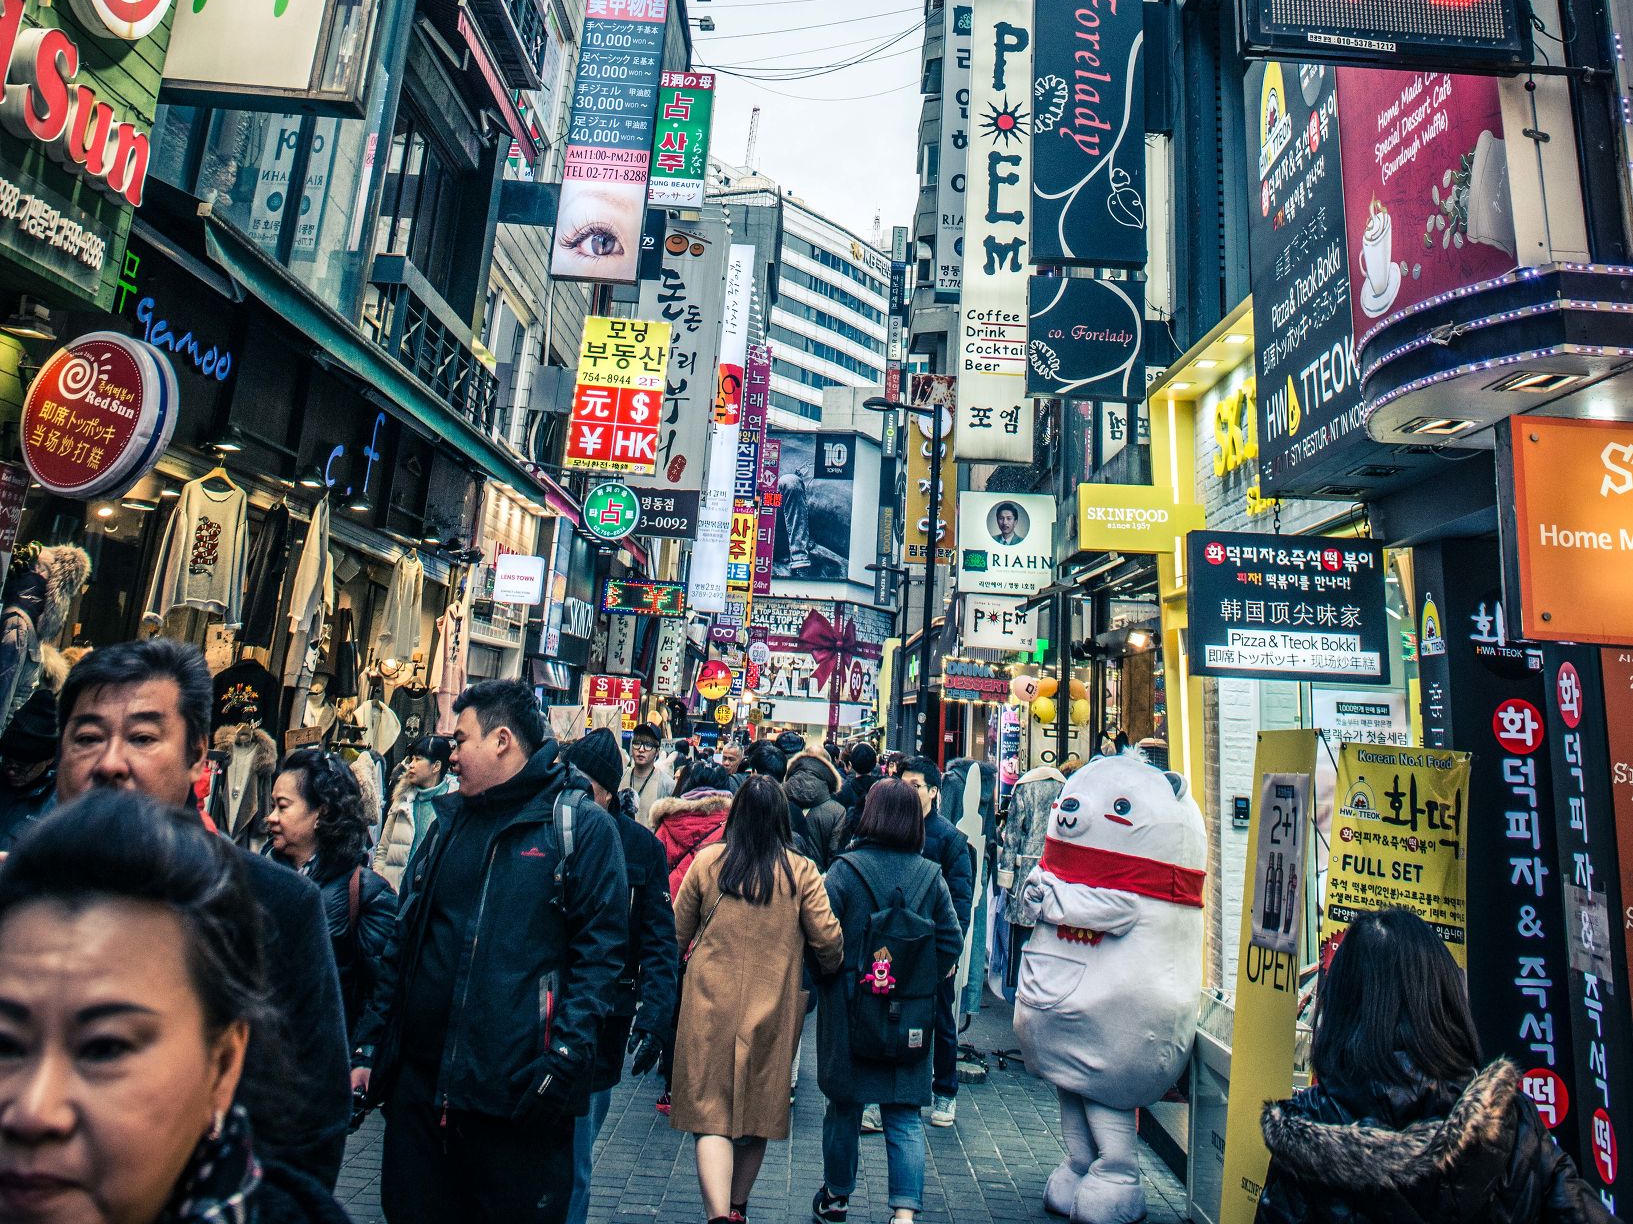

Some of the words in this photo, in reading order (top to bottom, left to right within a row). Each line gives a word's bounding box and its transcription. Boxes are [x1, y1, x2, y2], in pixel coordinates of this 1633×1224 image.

[585, 33, 631, 48] 10,000
[581, 64, 627, 79] 20,000
[575, 95, 624, 111] 30,000
[663, 92, 695, 121] 占
[1377, 100, 1400, 133] Home
[1401, 75, 1423, 110] Made
[25, 28, 151, 208] Sun
[1374, 121, 1400, 166] Special
[1401, 95, 1432, 139] Dessert
[571, 129, 619, 143] 40,000
[1381, 134, 1421, 186] (Sourdough
[1421, 108, 1449, 147] Waffle)
[656, 131, 689, 174] 사주
[690, 128, 704, 175] うらない
[565, 165, 584, 178] TEL
[586, 166, 648, 182] 02-771-8288
[966, 309, 1021, 323] Coffee
[1271, 297, 1290, 333] Pizza
[606, 320, 650, 342] 모닝
[966, 325, 1007, 339] Drink
[1048, 328, 1065, 339] co.
[1071, 324, 1134, 347] Forelady
[582, 342, 666, 373] 부동산
[965, 342, 1027, 356] Cocktail
[965, 358, 1001, 372] Beer
[582, 372, 632, 386] 754-8944
[638, 377, 661, 387] 2F
[84, 389, 109, 410] Red
[110, 400, 135, 421] Sun
[580, 389, 612, 417] 元
[38, 400, 116, 445] 即席トッポッキ
[969, 405, 1022, 435] 포엠
[29, 425, 105, 471] 当场炒打糕
[614, 431, 657, 459] HK
[823, 442, 849, 468] 10
[600, 498, 624, 526] 占
[641, 496, 675, 513] 명동점
[1086, 506, 1169, 524] SKINFOOD
[729, 516, 751, 560] 사주
[1106, 522, 1130, 530] since
[1131, 522, 1152, 531] 1957
[1539, 523, 1613, 551] Home
[992, 553, 1053, 571] RIAHN
[753, 580, 768, 590] 24hr
[1236, 572, 1263, 587] 피자!
[1265, 574, 1311, 591] 떡볶이를
[1313, 575, 1352, 593] 만나다!
[1220, 598, 1363, 629] 韩国顶尖味家
[1231, 632, 1266, 648] Pizza
[1268, 634, 1279, 648] &
[1281, 634, 1318, 651] Tteok
[1321, 636, 1357, 652] Bokki
[1476, 645, 1497, 656] HWA
[944, 674, 1009, 694] DESSERT
[1358, 749, 1397, 764] Korean
[1399, 753, 1424, 767] No.1
[1427, 755, 1453, 769] Food
[1557, 672, 1594, 899] 화덕피자
[1498, 705, 1550, 897] 화덕피자
[1270, 804, 1298, 847] 2+1
[1381, 772, 1462, 860] 화떡
[1341, 853, 1386, 878] FULL
[1391, 860, 1424, 884] SET
[1516, 904, 1546, 939] &
[1245, 941, 1298, 996] OPEN
